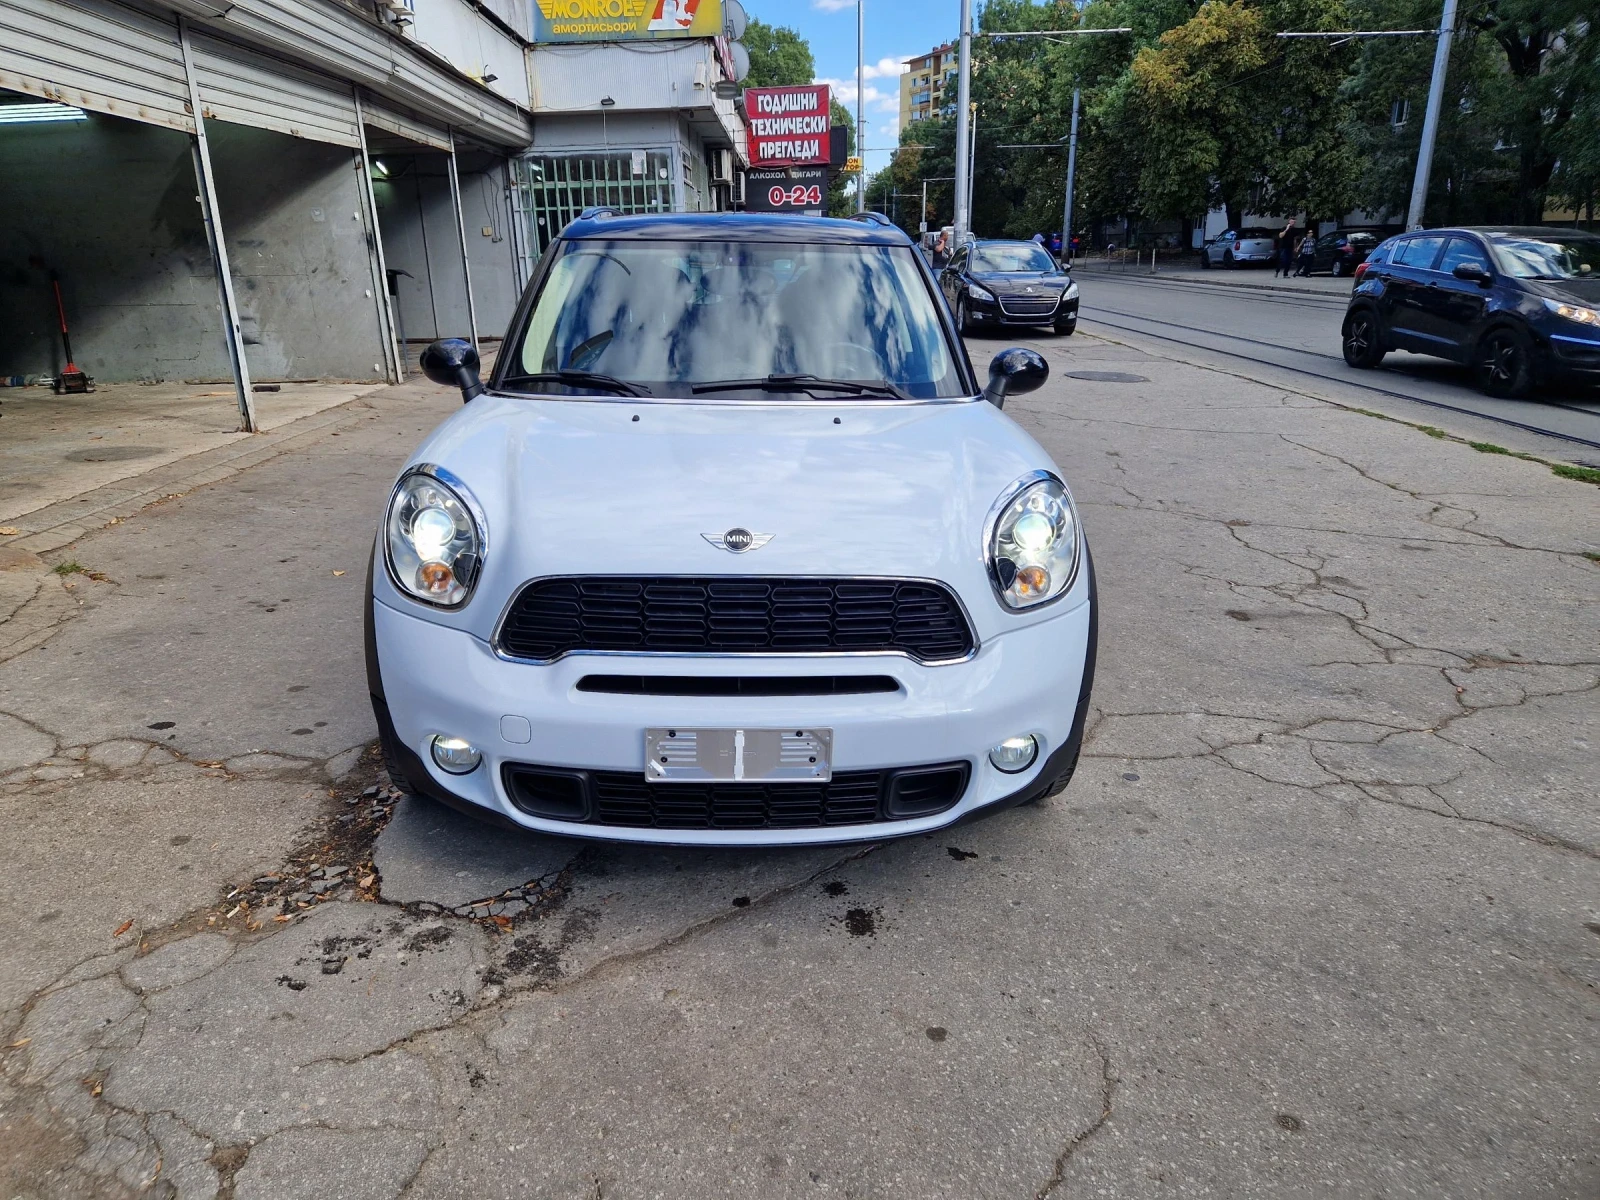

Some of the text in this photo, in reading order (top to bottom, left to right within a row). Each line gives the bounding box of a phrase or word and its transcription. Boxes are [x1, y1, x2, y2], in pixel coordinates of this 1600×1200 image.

[552, 0, 636, 19] MONROE
[552, 22, 637, 35] амортисьори
[757, 93, 817, 114] ГОДИШНИ
[751, 116, 826, 135] ТЕХНИЧЕСКИ
[760, 140, 819, 159] ПРЕГЛЕДИ
[769, 185, 821, 205] 0-24
[726, 535, 750, 543] MINI
